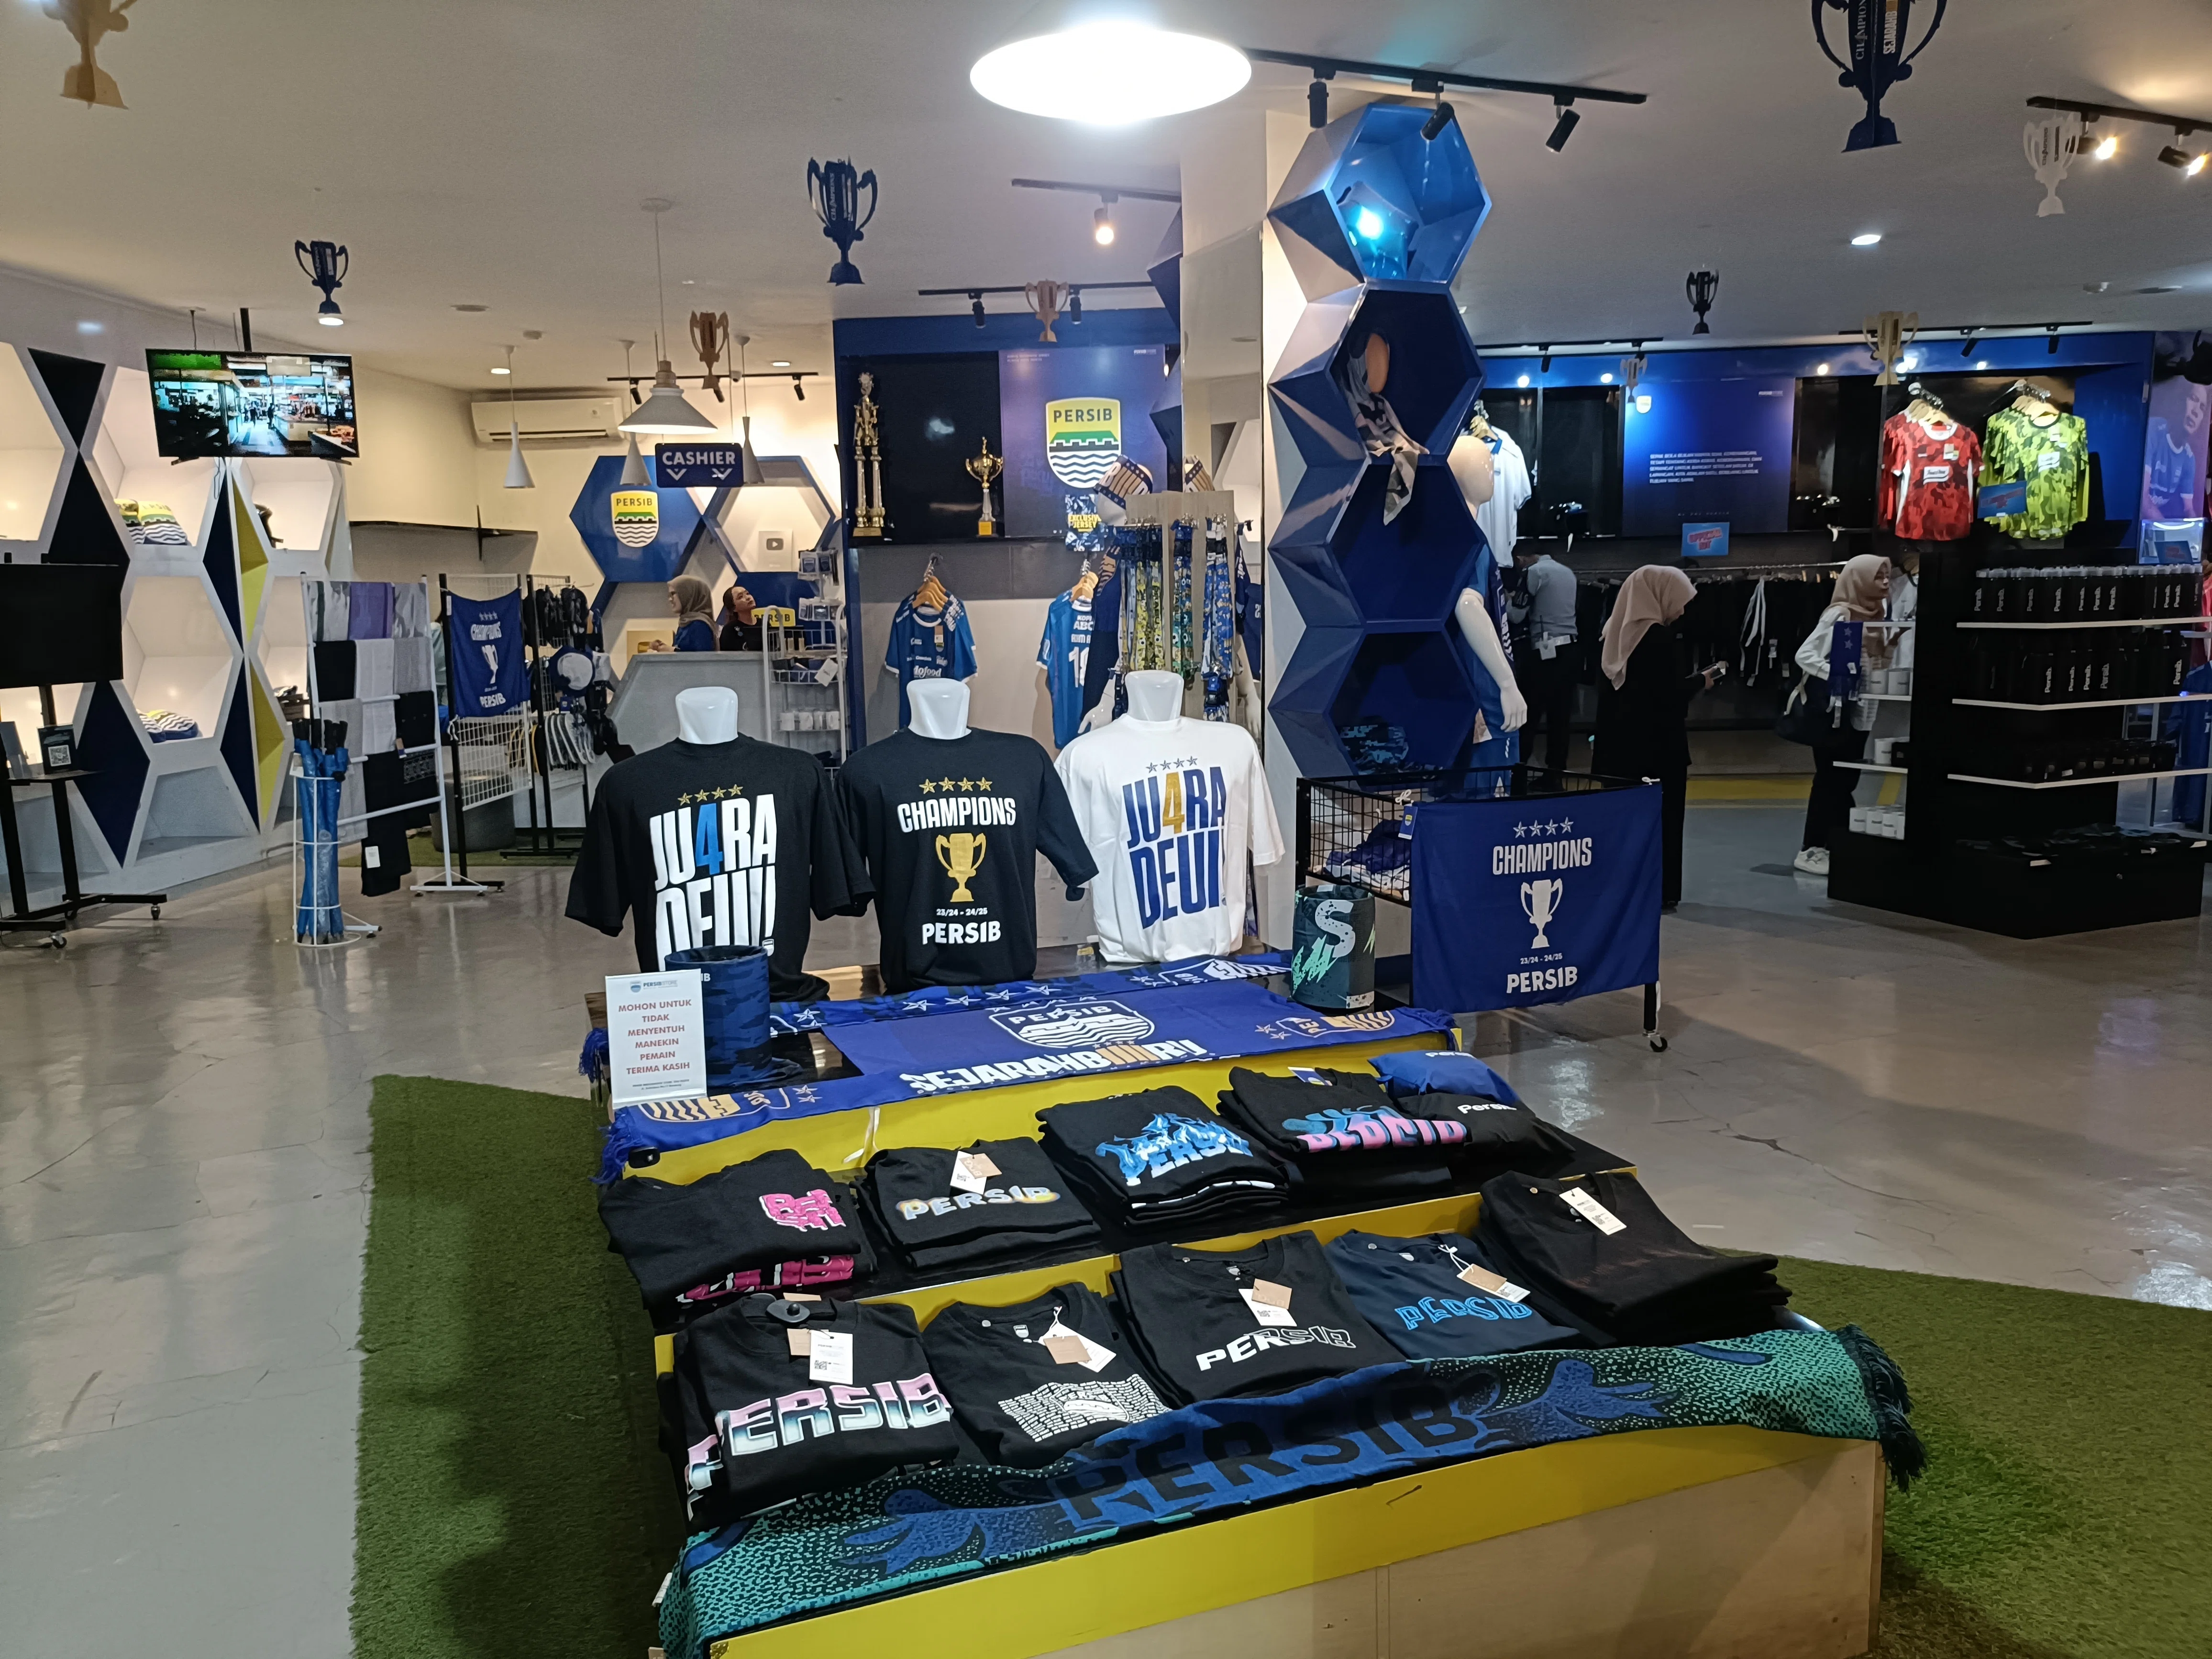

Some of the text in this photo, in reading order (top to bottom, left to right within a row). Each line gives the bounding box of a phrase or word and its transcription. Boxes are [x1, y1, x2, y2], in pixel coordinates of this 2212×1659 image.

[1054, 409, 1113, 423] PERSIB
[662, 451, 736, 465] CASHIER
[616, 498, 653, 507] PERSIB
[1073, 520, 1097, 529] JERSEY
[1073, 621, 1094, 631] ABC
[480, 693, 506, 708] PERSIB
[897, 796, 1017, 834] CHAMPIONS
[1122, 766, 1227, 850] JU4RA
[650, 794, 777, 891] JU4RA
[1492, 837, 1592, 876] CHAMPIONS
[936, 908, 958, 918] 23/24
[965, 907, 988, 917] 24/25
[922, 920, 1001, 946] PERSIB
[1520, 956, 1538, 964] 23/24
[1545, 952, 1563, 962] 24/25
[1506, 966, 1578, 994] PERSIB
[619, 999, 692, 1013] MOHON UNTUK
[642, 1014, 670, 1023] TIDAK
[1008, 1006, 1113, 1025] PERSIB
[628, 1025, 685, 1037] MENYENTUH
[635, 1038, 679, 1049] MANEKIN
[640, 1051, 675, 1061] PEMAIN
[626, 1062, 690, 1075] TERIMA KASIH
[896, 1185, 1060, 1220] PERSIB
[1394, 1296, 1533, 1330] PERSIB
[1196, 1326, 1357, 1371] PERSIB
[1055, 1385, 1478, 1521] PERSIB
